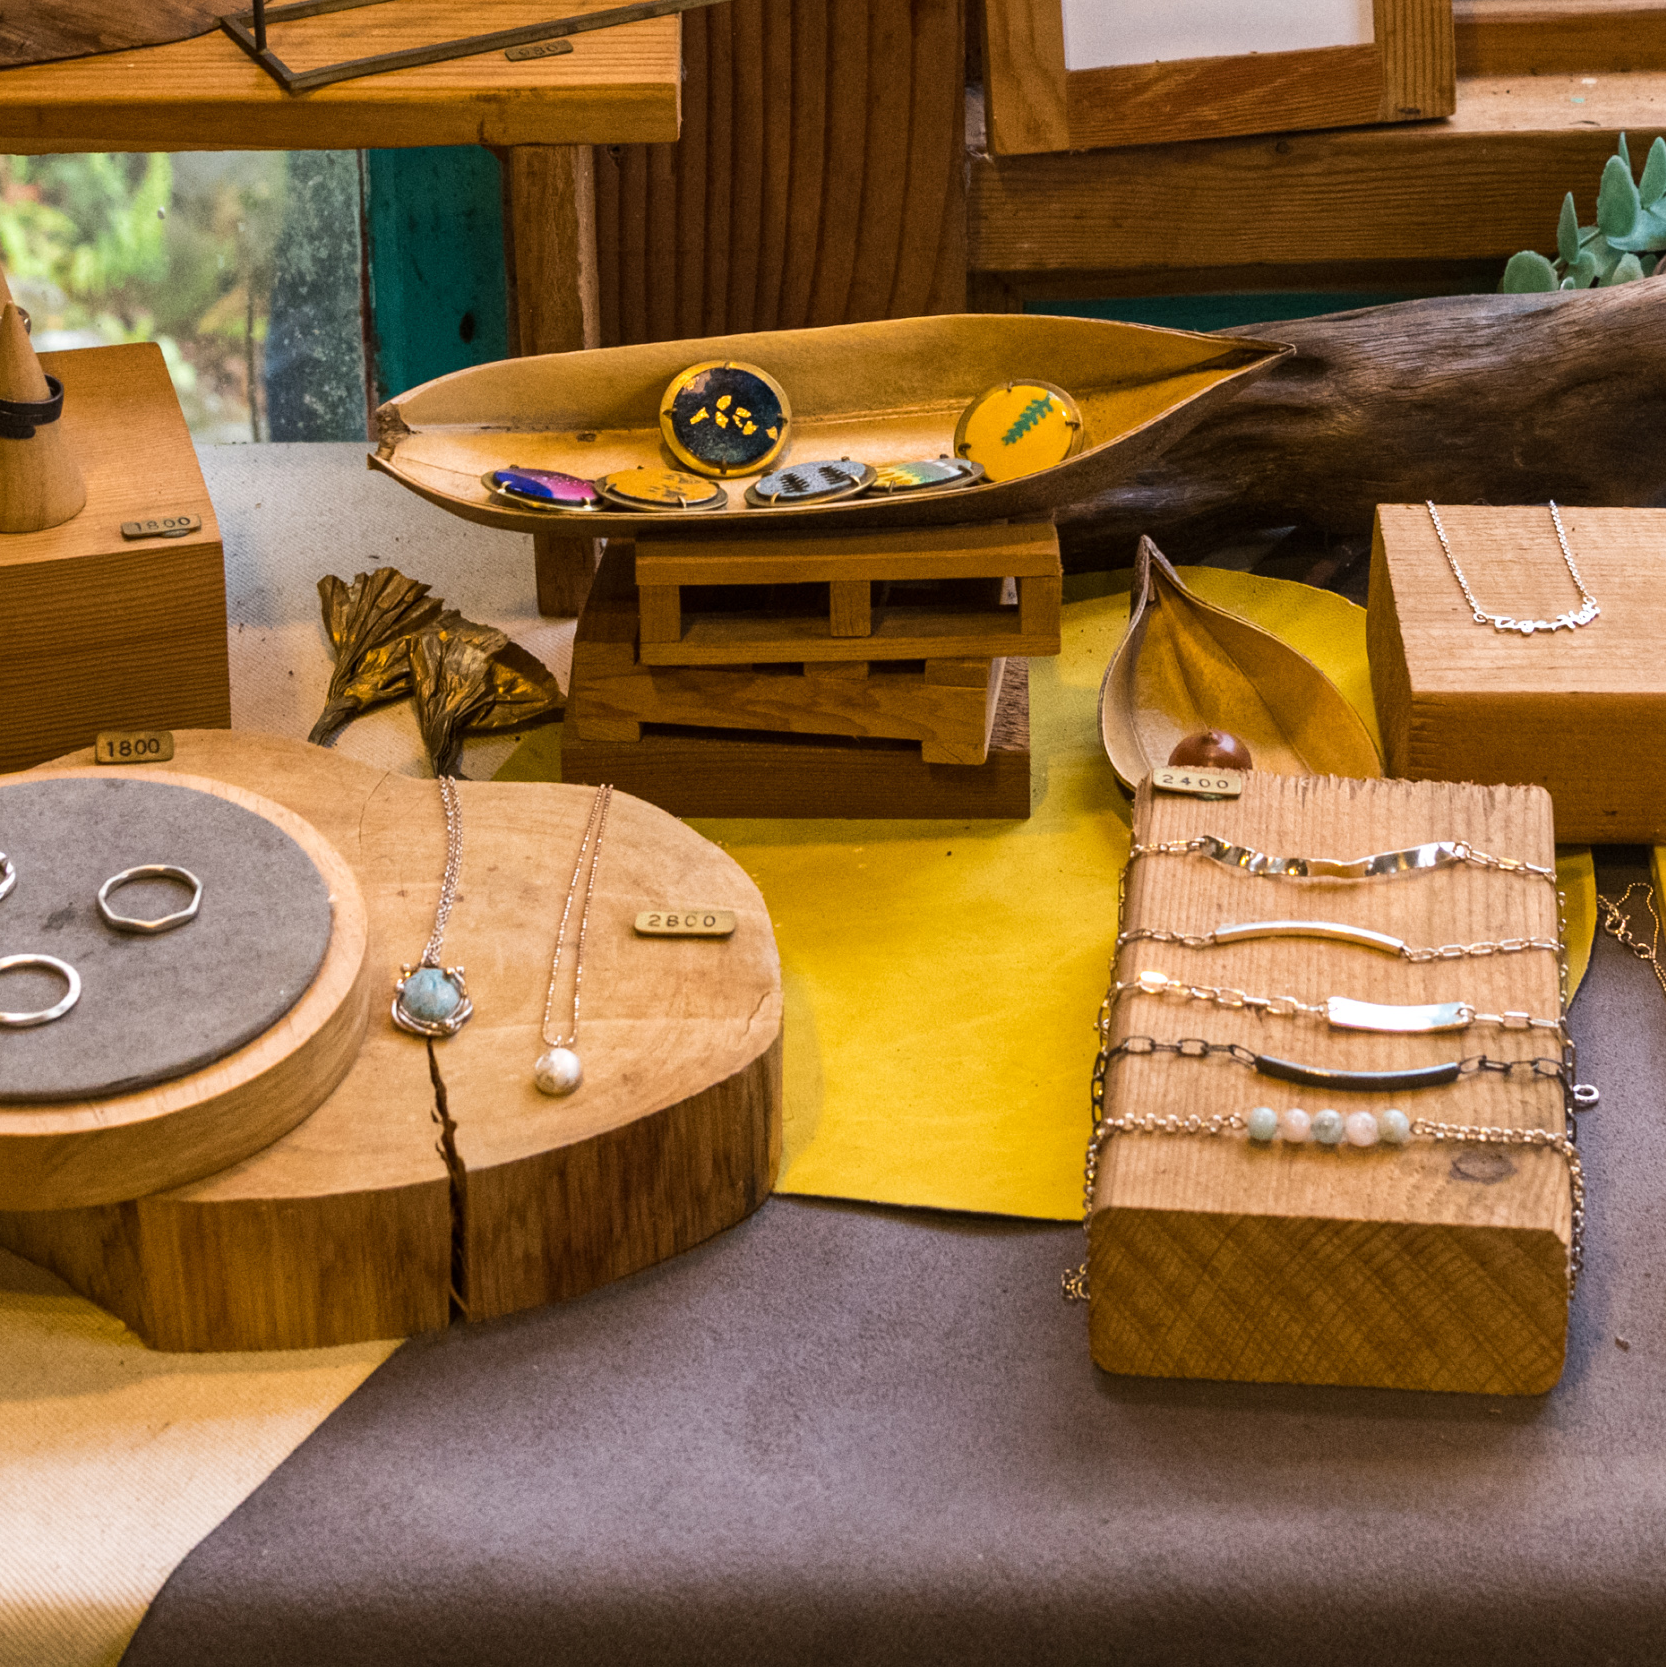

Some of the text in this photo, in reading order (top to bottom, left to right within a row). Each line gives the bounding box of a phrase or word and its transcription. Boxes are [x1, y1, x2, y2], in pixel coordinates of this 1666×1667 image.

[134, 516, 191, 532] 1800
[107, 737, 160, 758] 1800
[1162, 774, 1229, 789] 2400
[648, 914, 716, 928] 2800
